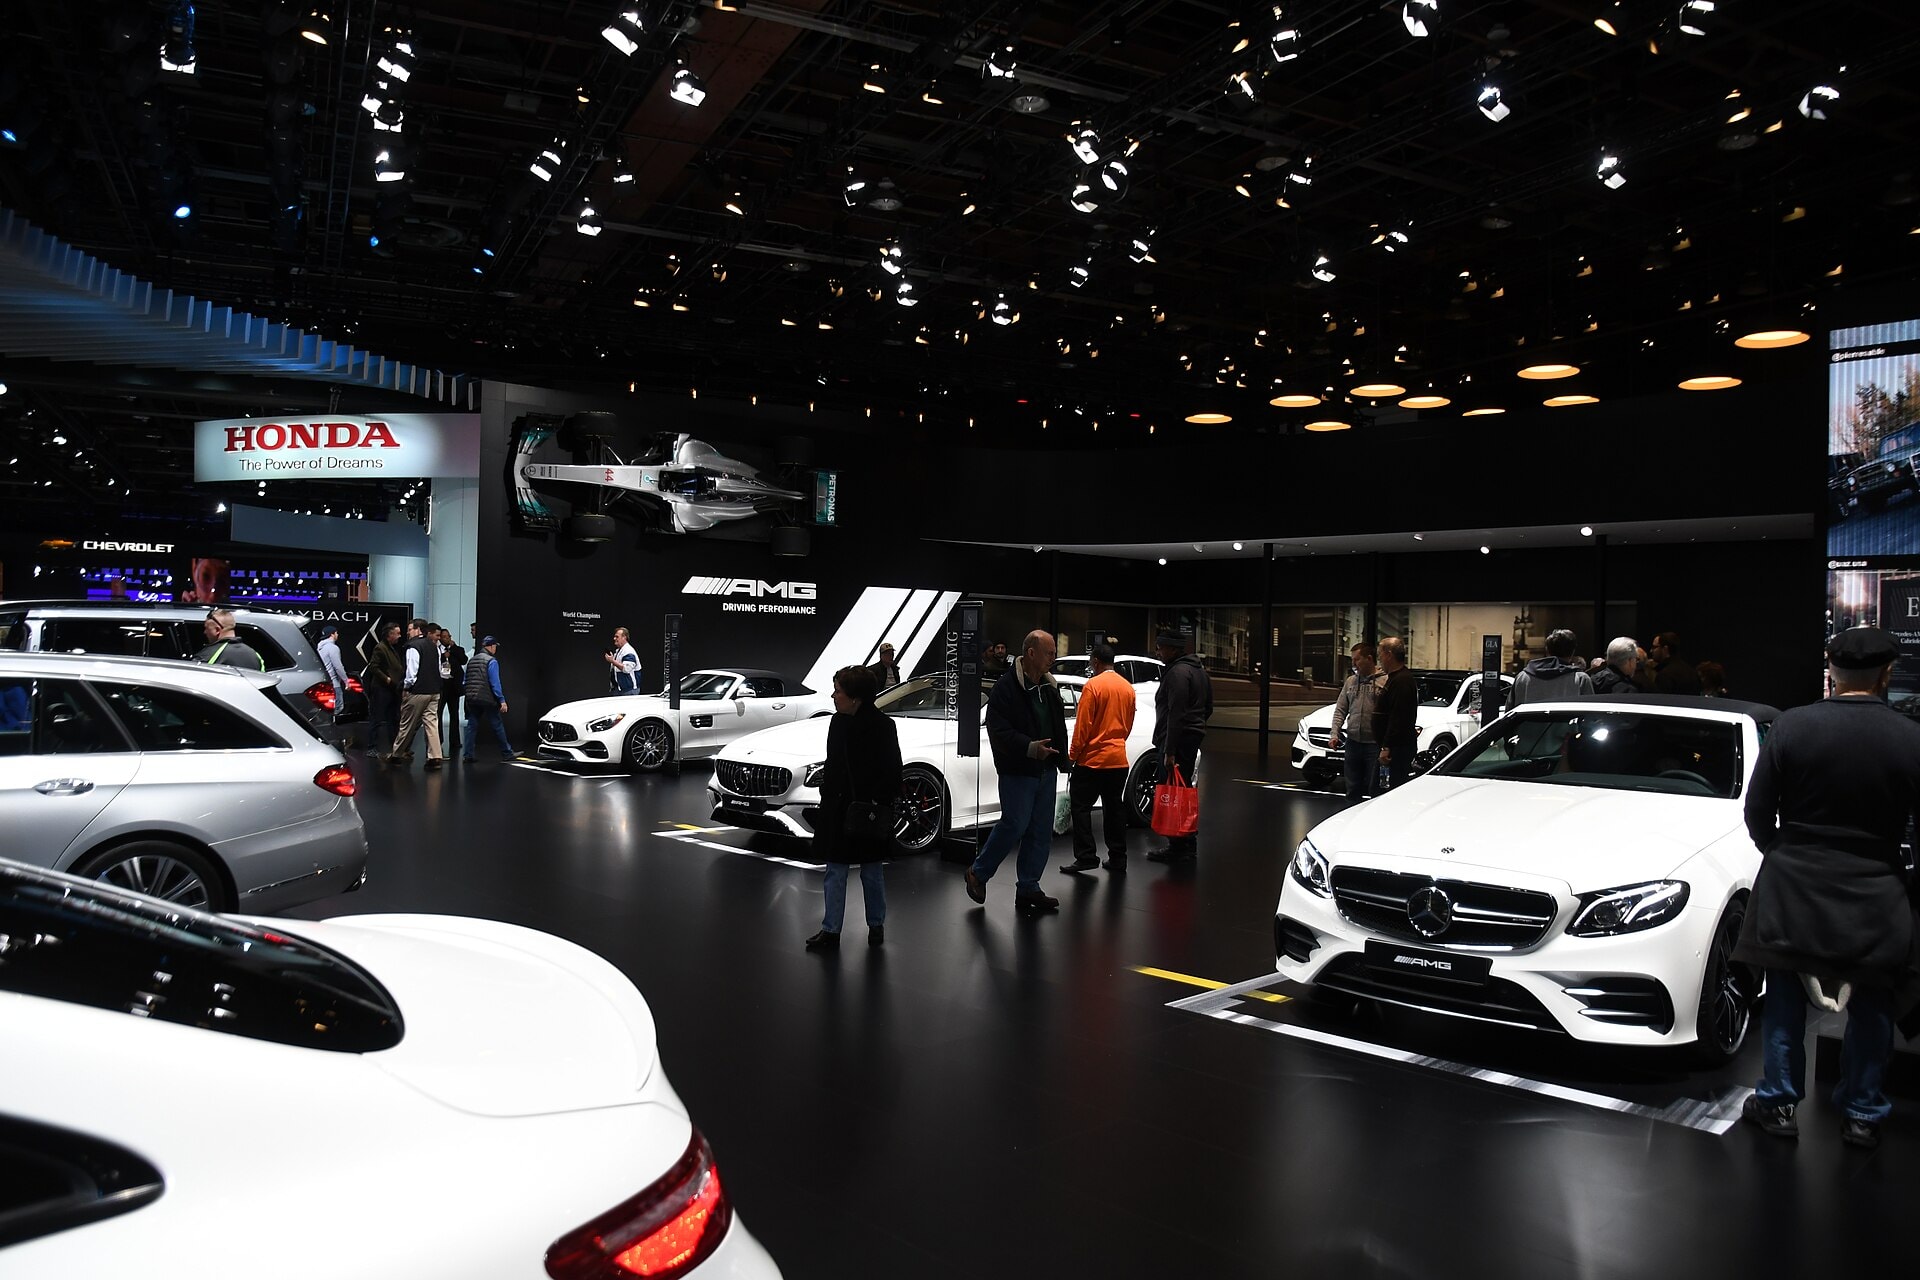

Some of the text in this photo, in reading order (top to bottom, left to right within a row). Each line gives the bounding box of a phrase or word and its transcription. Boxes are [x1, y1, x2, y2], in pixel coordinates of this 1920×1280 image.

[224, 422, 401, 452] HONDA
[239, 456, 383, 471] The Power of Dreams
[604, 468, 614, 483] 44
[827, 474, 837, 522] PETRONAS
[83, 540, 175, 553] CHEVROLET
[722, 577, 817, 600] AMG
[278, 609, 369, 622] AYBACH
[722, 602, 817, 615] DRIVING PERFORMANCE
[1485, 640, 1498, 649] GLA
[945, 631, 959, 720] rcedes-AMG
[1410, 957, 1452, 971] AMG
